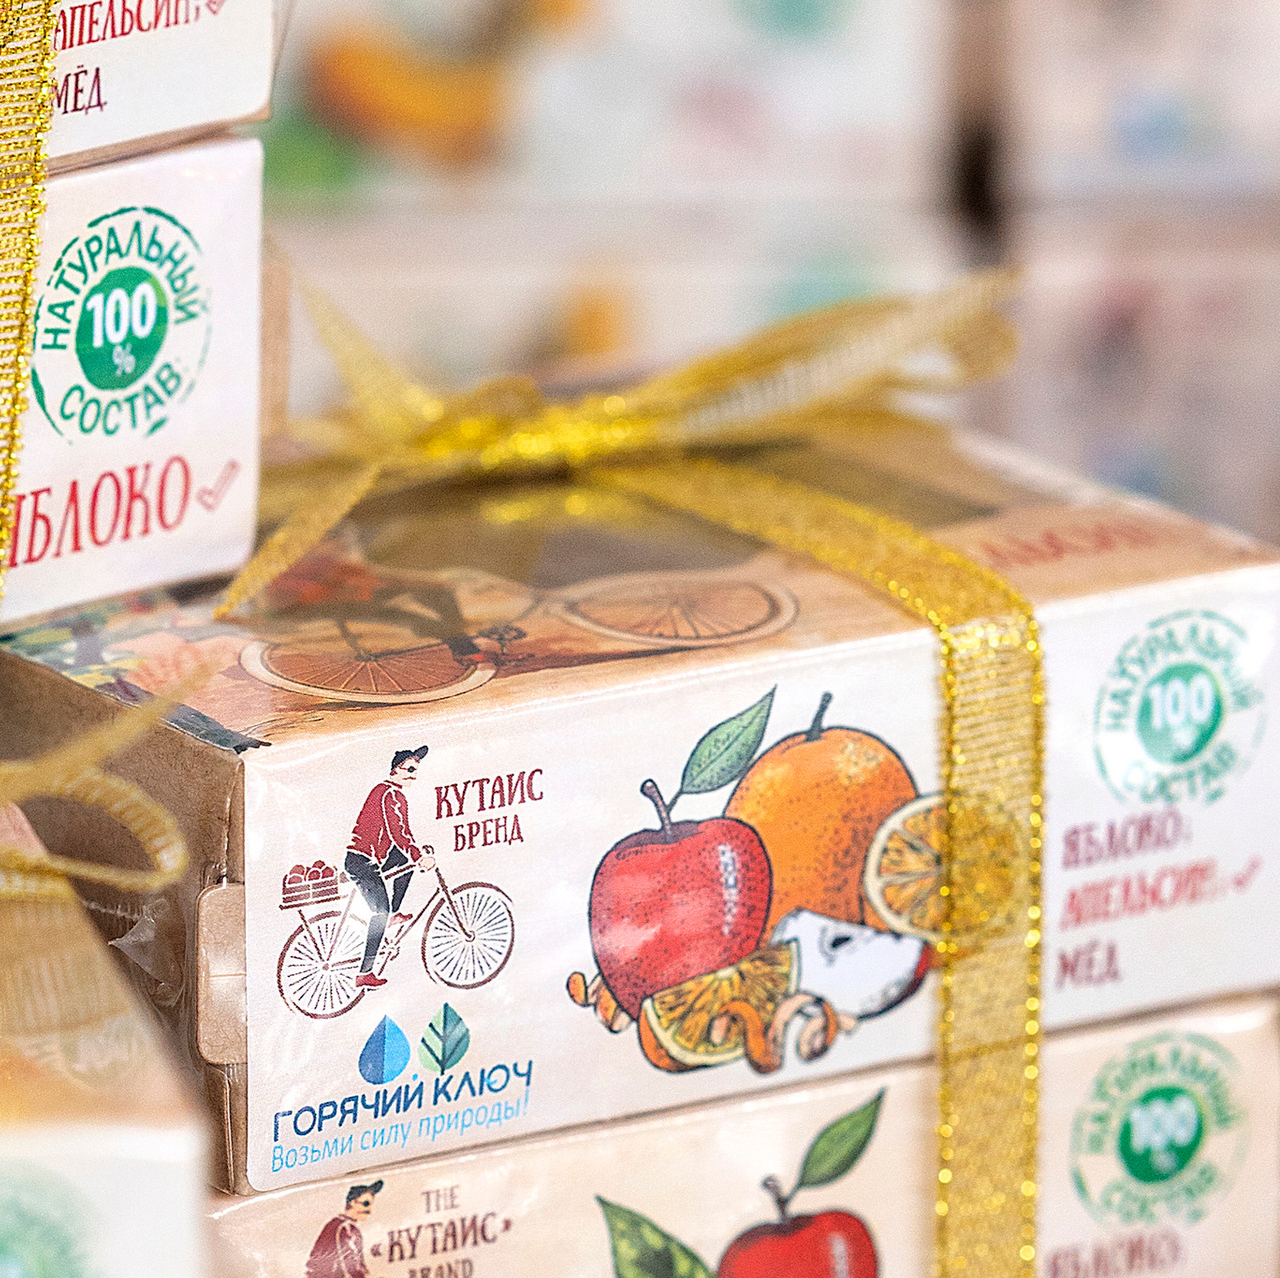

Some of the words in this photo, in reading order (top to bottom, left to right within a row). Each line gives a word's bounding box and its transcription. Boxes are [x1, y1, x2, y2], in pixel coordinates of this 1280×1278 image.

[42, 220, 211, 351] НАТУРАЛЬНЫЙ
[86, 282, 158, 349] 100
[60, 361, 183, 436] СОСТАВ
[1149, 671, 1215, 730] 100
[435, 768, 544, 820] КУТАИС
[453, 814, 524, 852] БРЕНД
[272, 1135, 354, 1174] Возьми
[360, 1119, 412, 1157] силу
[418, 1084, 532, 1145] природы!
[273, 1073, 425, 1142] ГОРЯЧИЙ
[433, 1060, 533, 1107] КЛЮЧ
[422, 1185, 461, 1214] THE
